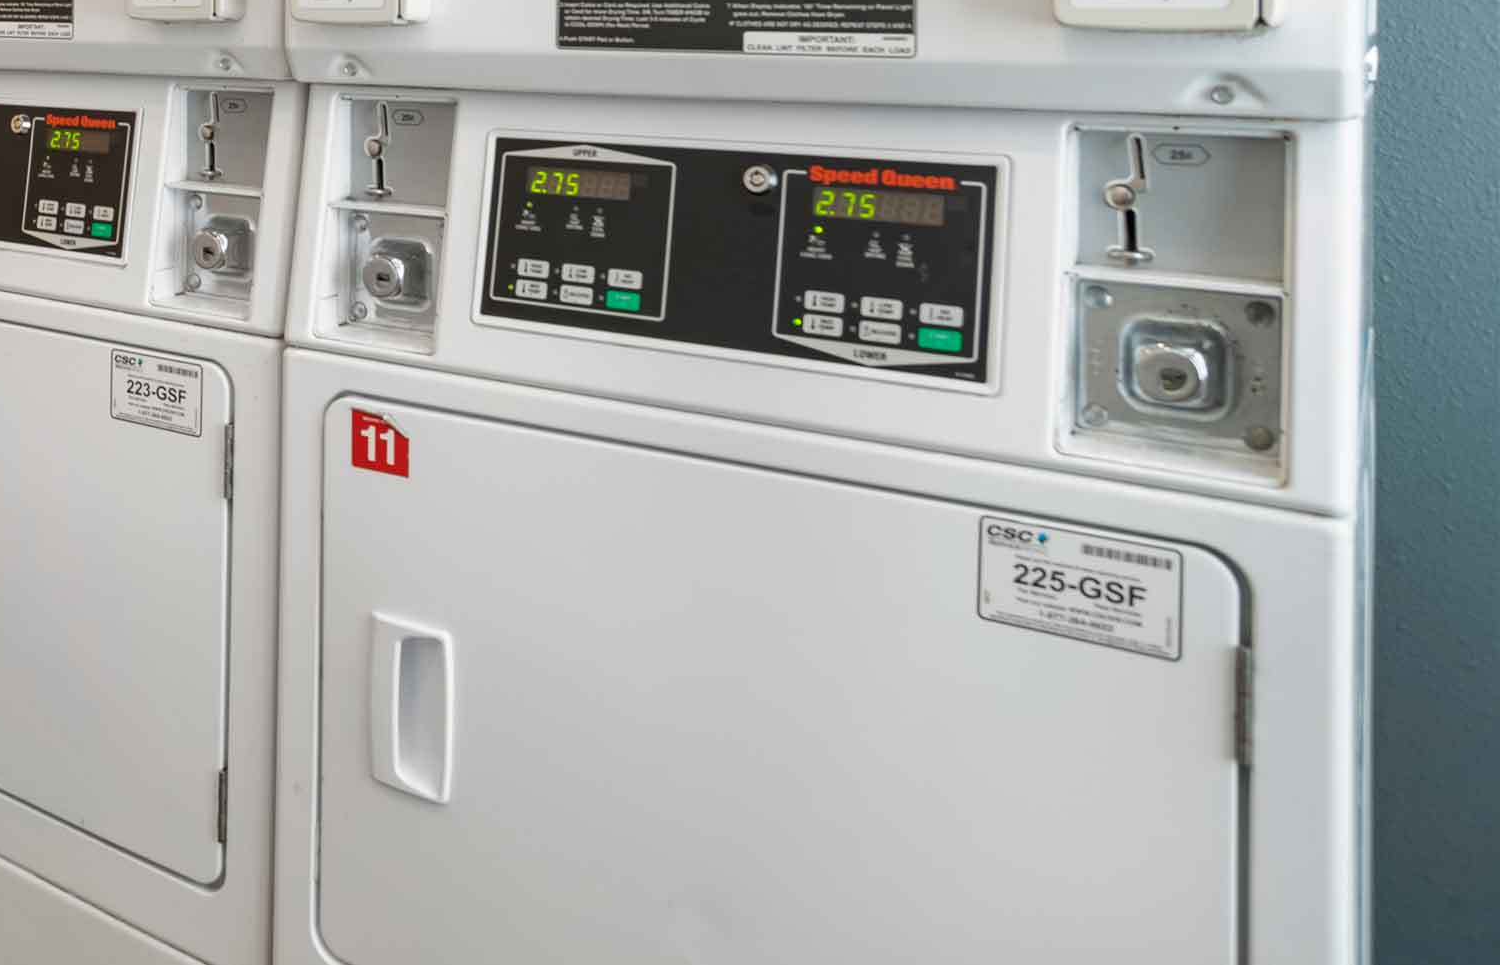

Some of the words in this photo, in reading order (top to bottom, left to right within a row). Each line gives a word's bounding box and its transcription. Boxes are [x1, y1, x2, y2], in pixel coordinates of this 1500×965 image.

[46, 113, 79, 128] Speed
[81, 115, 116, 130] Queen
[50, 131, 81, 150] 2.75
[573, 149, 598, 158] UPPER
[531, 171, 580, 196] 2.75
[808, 165, 878, 186] Speed
[881, 169, 956, 191] Queen
[815, 190, 876, 219] 2.75
[115, 354, 136, 366] CSC
[853, 349, 887, 361] LOWER
[126, 379, 187, 404] 223-GSF
[361, 426, 395, 466] 11
[987, 524, 1034, 543] CSC
[1012, 563, 1148, 608] 225-GSF
